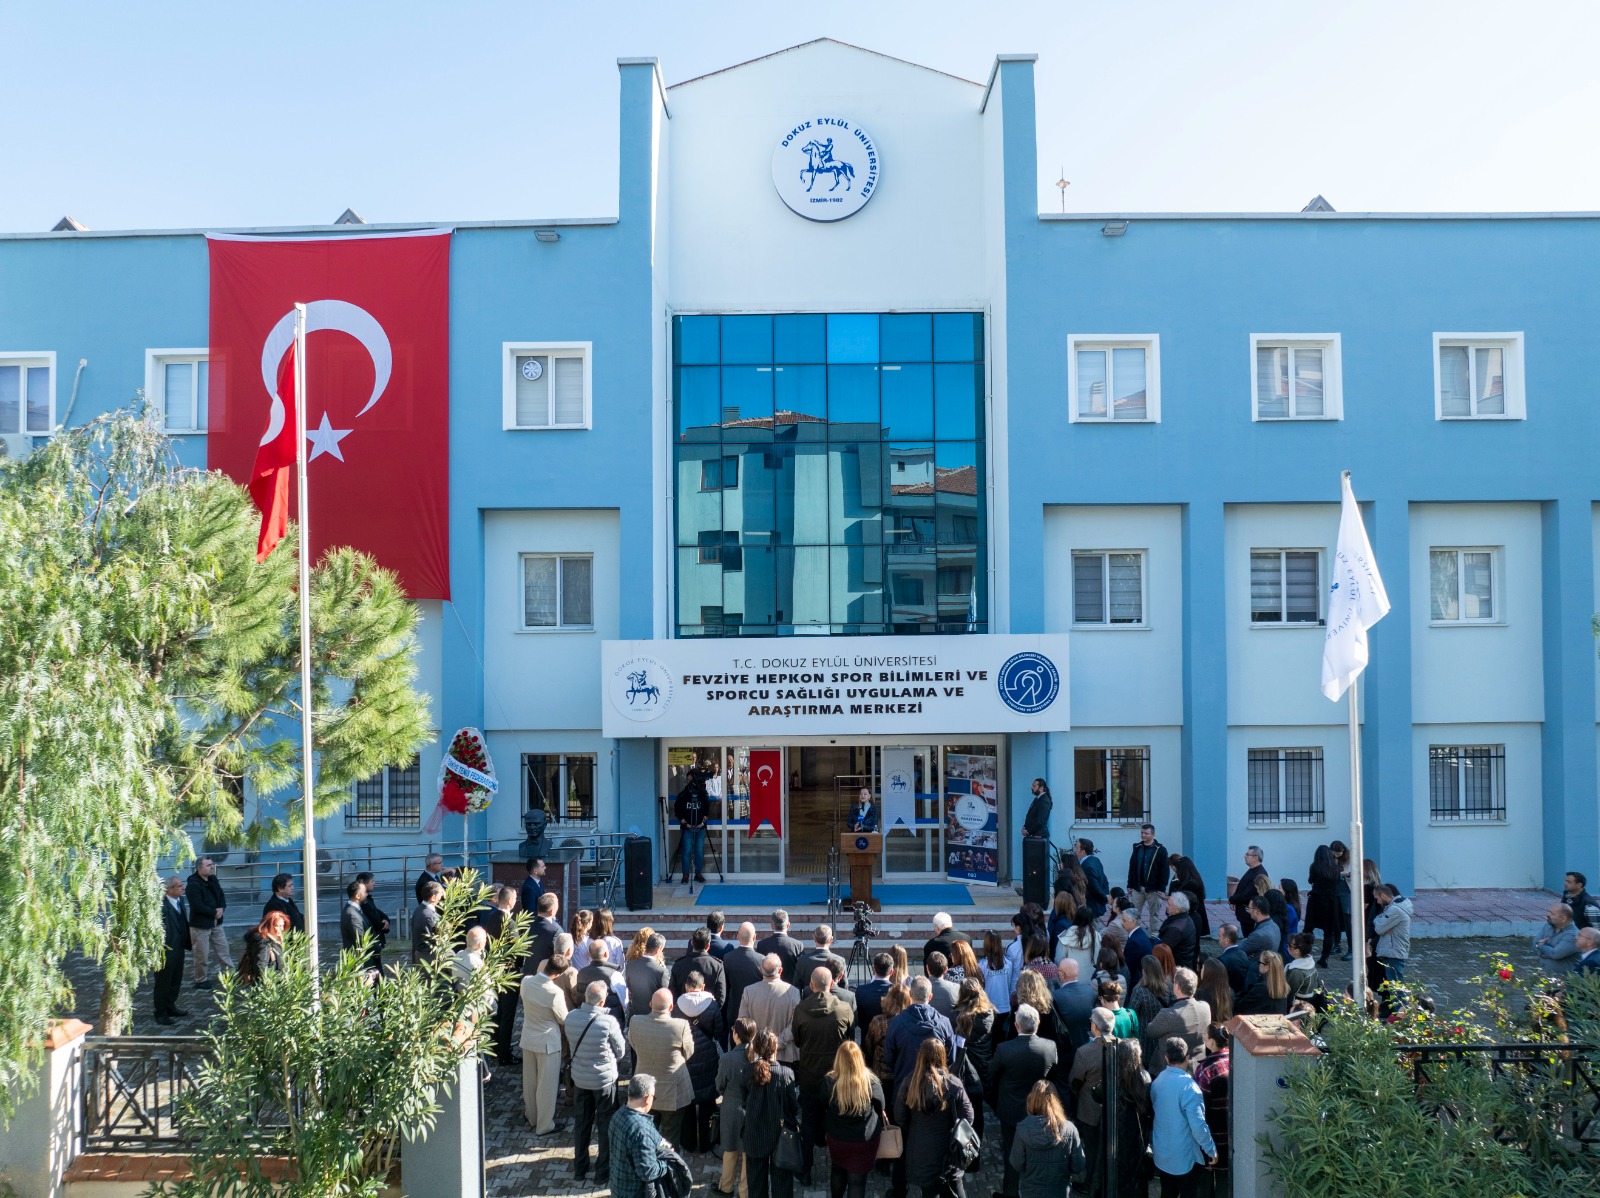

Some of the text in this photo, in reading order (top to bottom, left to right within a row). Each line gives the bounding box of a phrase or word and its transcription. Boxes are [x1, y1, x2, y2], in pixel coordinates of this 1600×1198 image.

[781, 118, 878, 198] DOKUZ EYLÜL ÜNİVERSİTESİ
[732, 654, 938, 669] T.C. DOKUZ EYLÜL ÜNİVERSİTESİ
[682, 669, 988, 685] FEVZİYE HEPKON SPOR BİLİMLERİ VE
[706, 686, 965, 701] SPORCU SAĞLIĞI UYGULAMA VE
[747, 702, 923, 718] ARAŞTIRMA MERKEZİ
